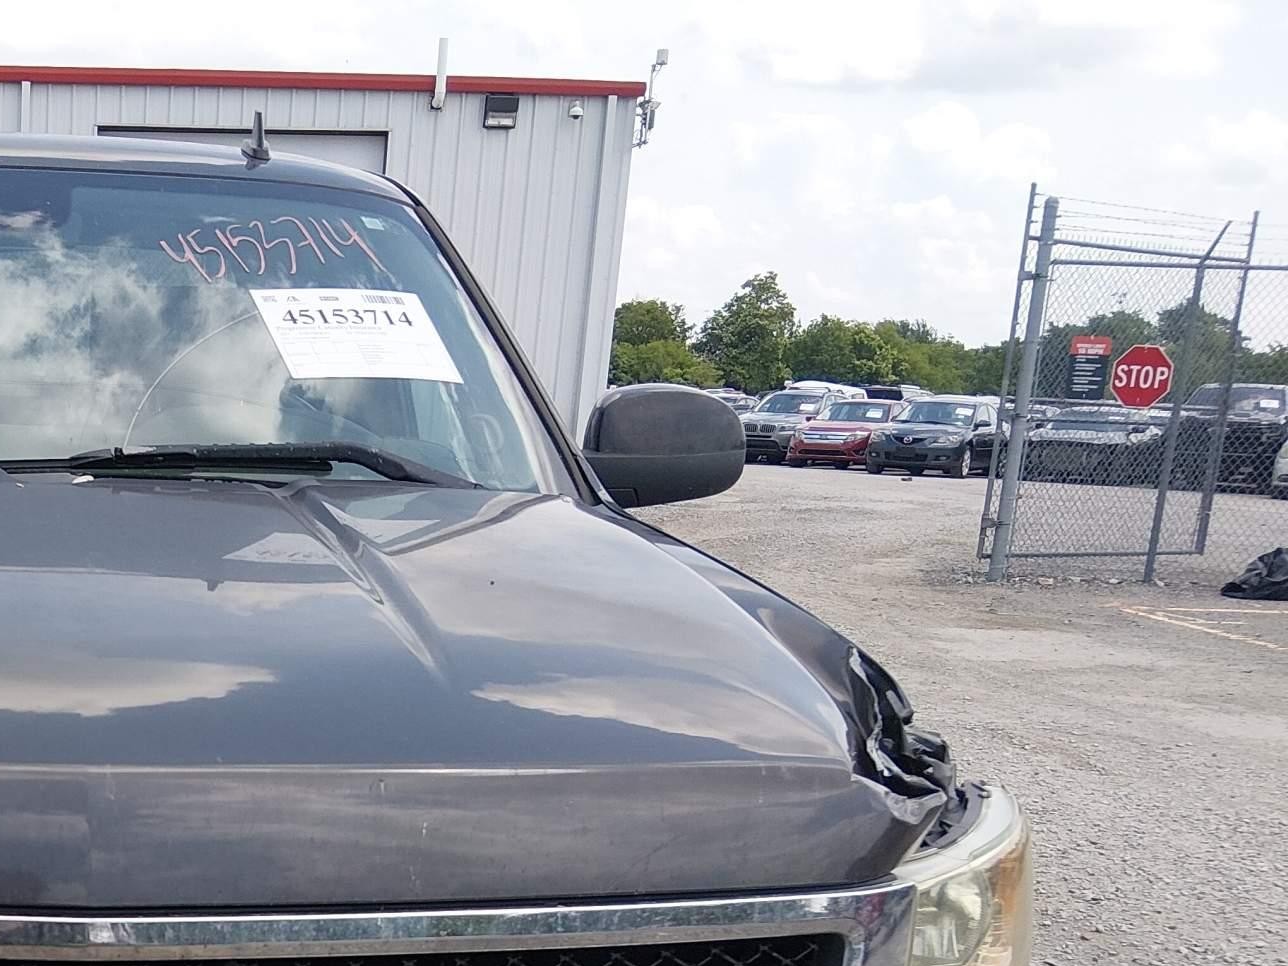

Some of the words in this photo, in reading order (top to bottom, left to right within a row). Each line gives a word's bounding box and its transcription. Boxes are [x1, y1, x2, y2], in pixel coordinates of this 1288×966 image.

[159, 215, 389, 284] 45153714
[281, 308, 415, 327] 45153714
[1114, 364, 1169, 389] STOP
